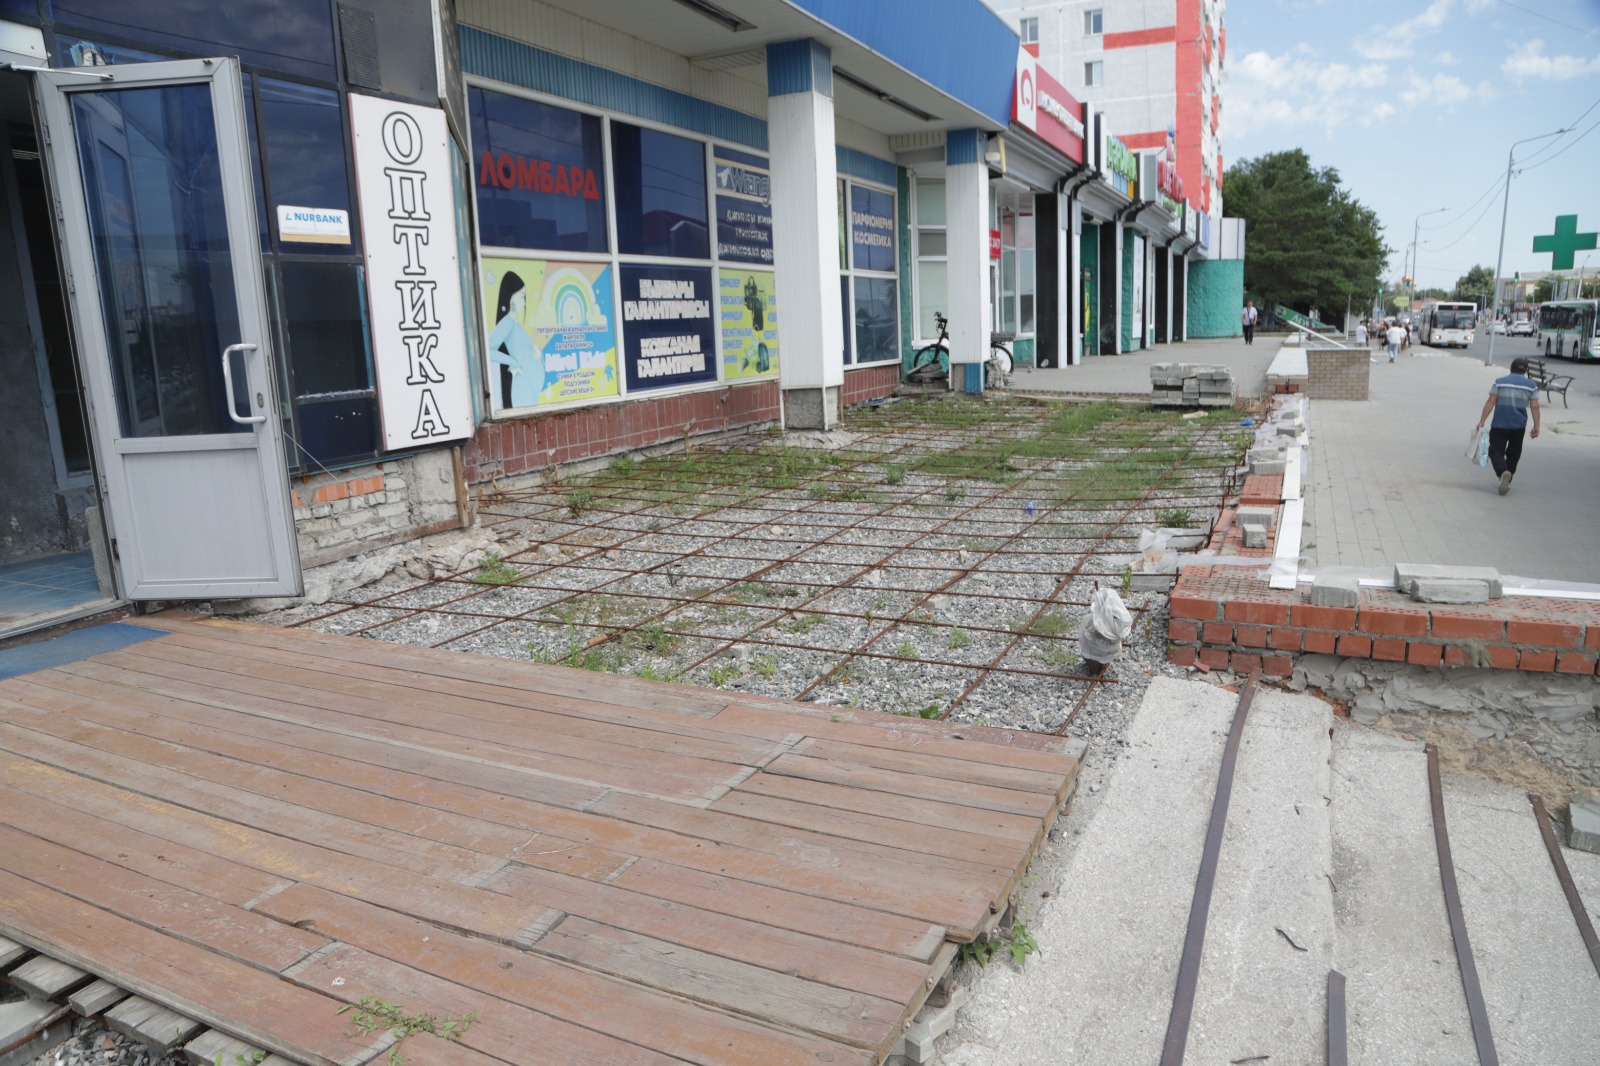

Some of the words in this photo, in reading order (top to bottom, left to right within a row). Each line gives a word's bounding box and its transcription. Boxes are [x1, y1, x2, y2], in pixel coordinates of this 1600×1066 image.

[480, 150, 600, 200] ЛОМБАРД
[294, 212, 343, 224] NURBANK
[852, 211, 893, 230] ПАРФЮМЕРИЯ
[854, 230, 892, 248] КОСМЕТИКА
[381, 110, 450, 440] ОПТИКА
